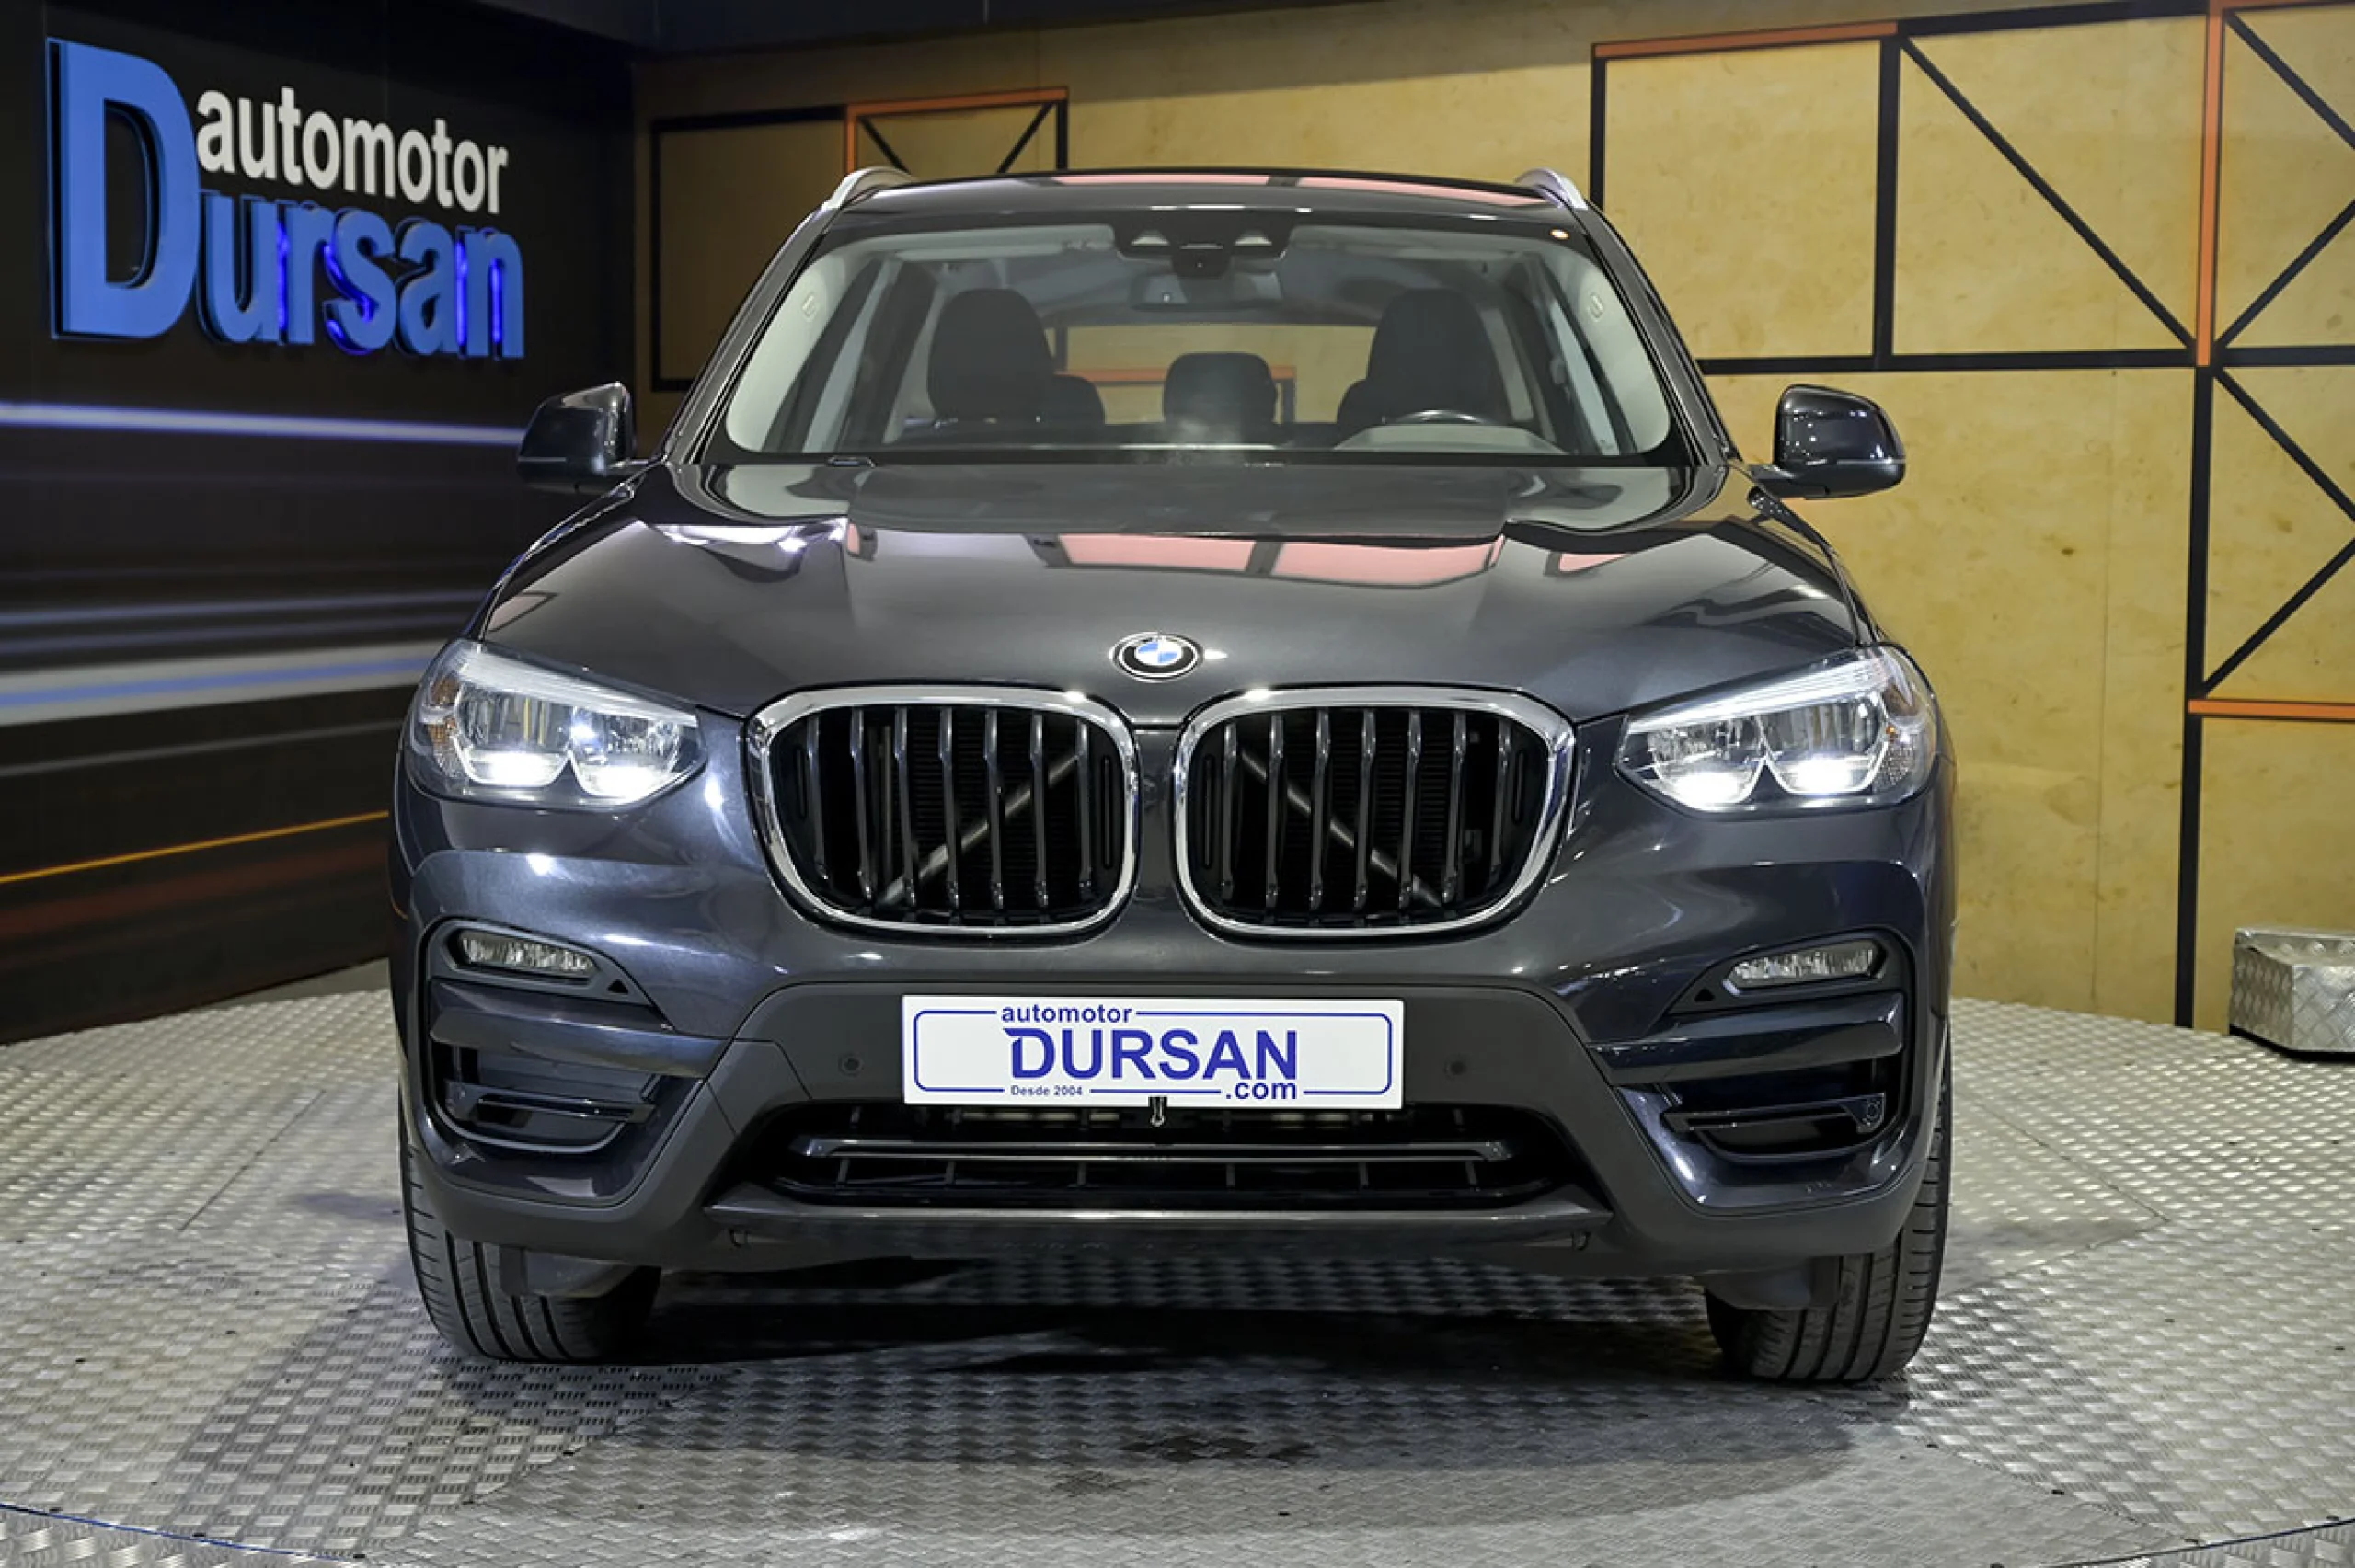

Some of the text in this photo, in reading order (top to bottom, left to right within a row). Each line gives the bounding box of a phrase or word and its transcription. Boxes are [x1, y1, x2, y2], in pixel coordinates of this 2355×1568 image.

[196, 86, 508, 213] automotor
[46, 37, 524, 360] Dursan
[1002, 1004, 1132, 1023] automotor
[1003, 1027, 1297, 1080] DURSAN
[1011, 1085, 1083, 1096] Desde 2004
[1226, 1082, 1297, 1100] .com
